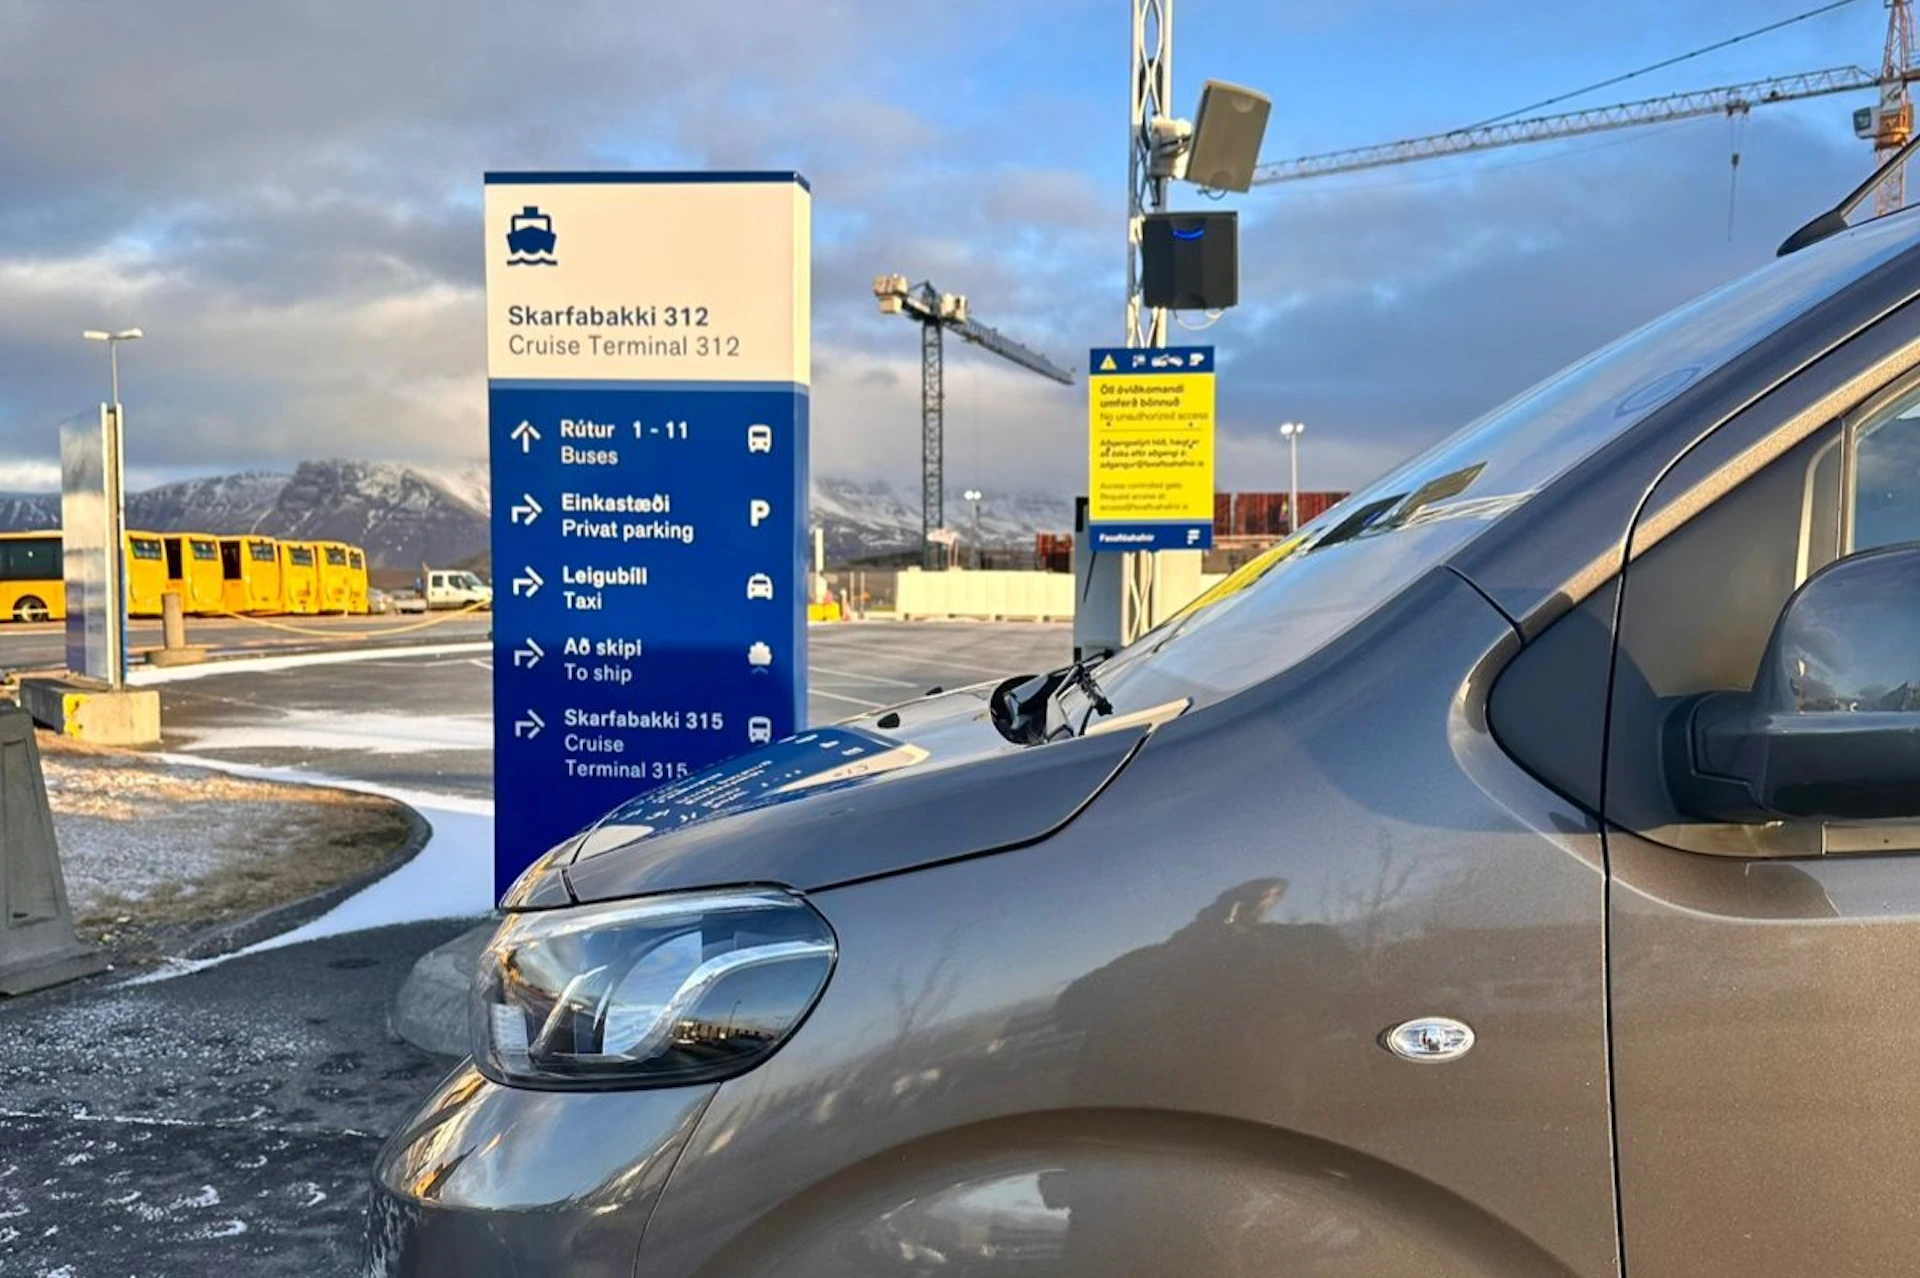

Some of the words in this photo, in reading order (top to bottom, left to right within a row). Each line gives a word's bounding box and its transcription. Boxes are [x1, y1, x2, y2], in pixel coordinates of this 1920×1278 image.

[508, 305, 657, 327] Skarfabakki
[664, 307, 710, 327] 312
[508, 335, 580, 355] Cruise
[588, 336, 688, 356] Terminal
[696, 336, 741, 357] 312
[560, 419, 615, 439] Rútur
[560, 446, 619, 465] Buses
[561, 493, 670, 513] Einkastæði
[562, 519, 618, 538] Privat
[623, 522, 694, 543] parking
[563, 591, 602, 610] Taxi
[564, 637, 590, 655] Að
[596, 638, 642, 660] skipi
[564, 663, 588, 681] To
[593, 664, 632, 685] ship
[564, 708, 679, 729] Skarfabakki
[685, 712, 724, 730] 315
[564, 733, 625, 752] Cruise
[565, 759, 646, 778] Terminal
[652, 761, 689, 779] 315
